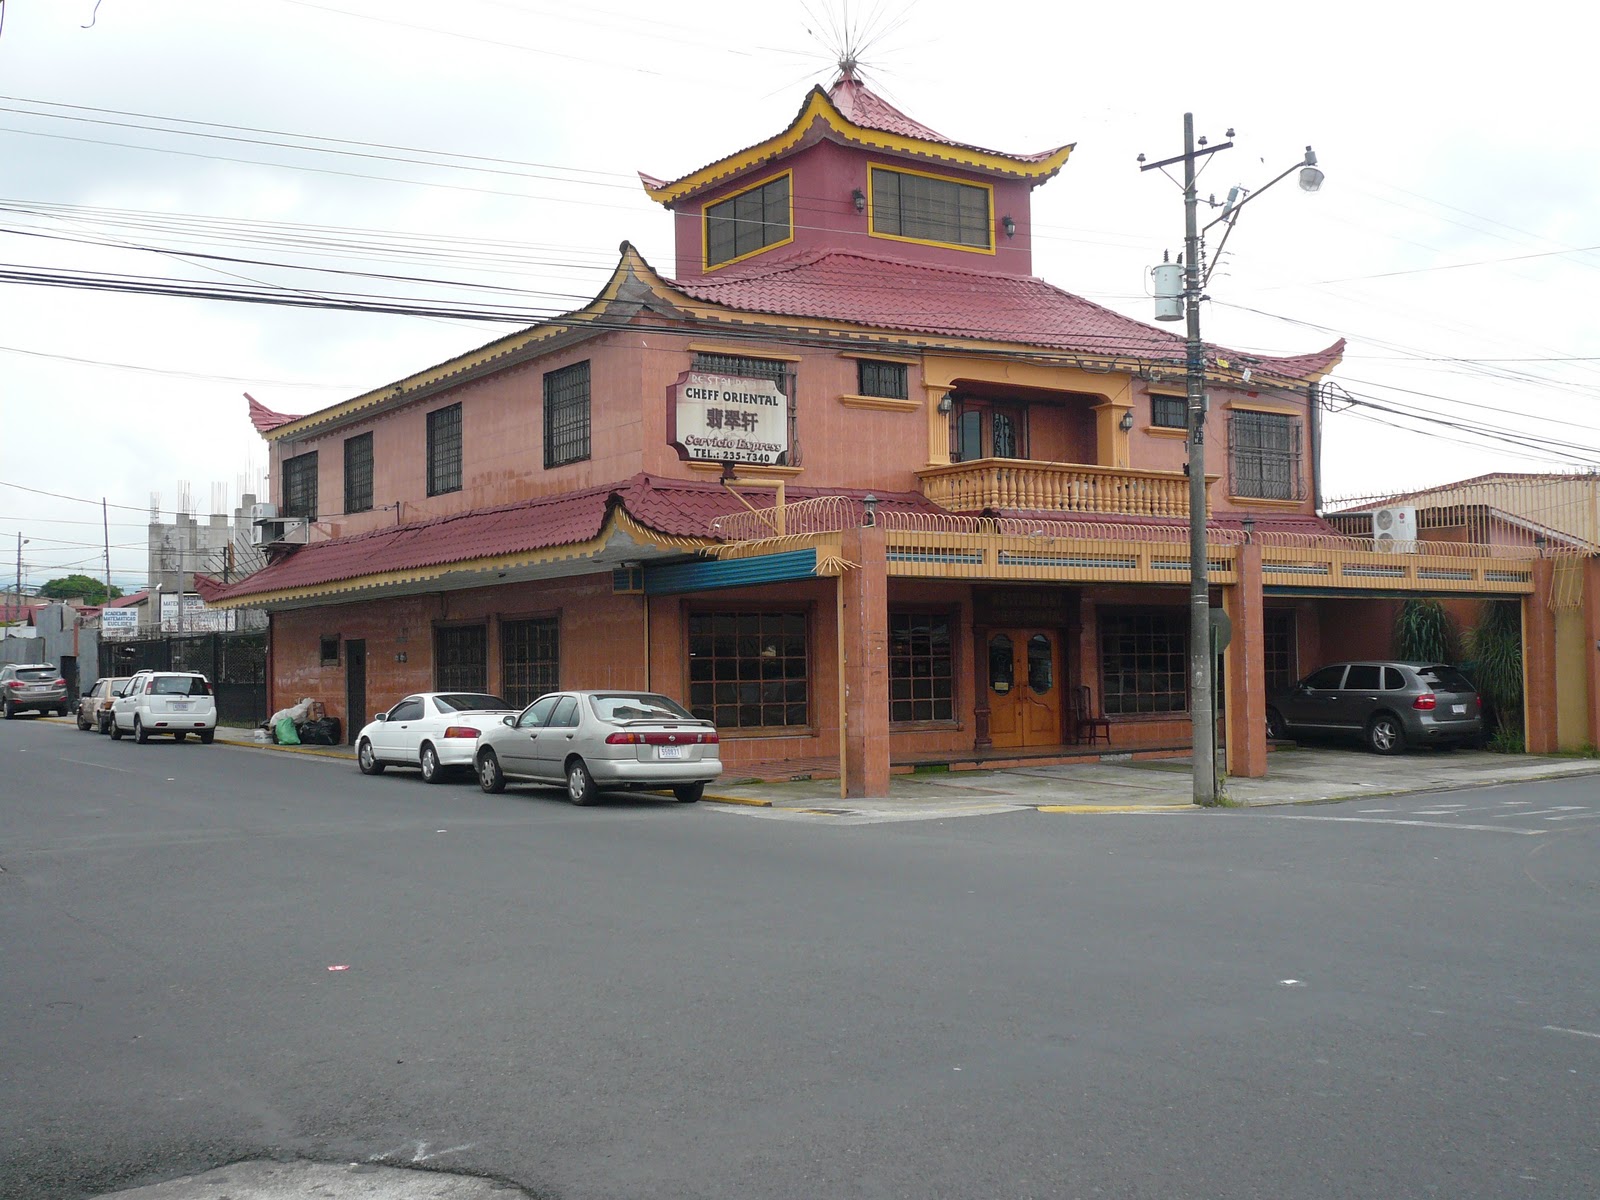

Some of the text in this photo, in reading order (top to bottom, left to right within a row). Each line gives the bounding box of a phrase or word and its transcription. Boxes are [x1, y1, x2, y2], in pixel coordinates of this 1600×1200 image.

[685, 387, 779, 406] CHEFF ORIENTAL
[685, 434, 782, 453] Servicio Express
[694, 448, 770, 463] TEL.: 235-7340
